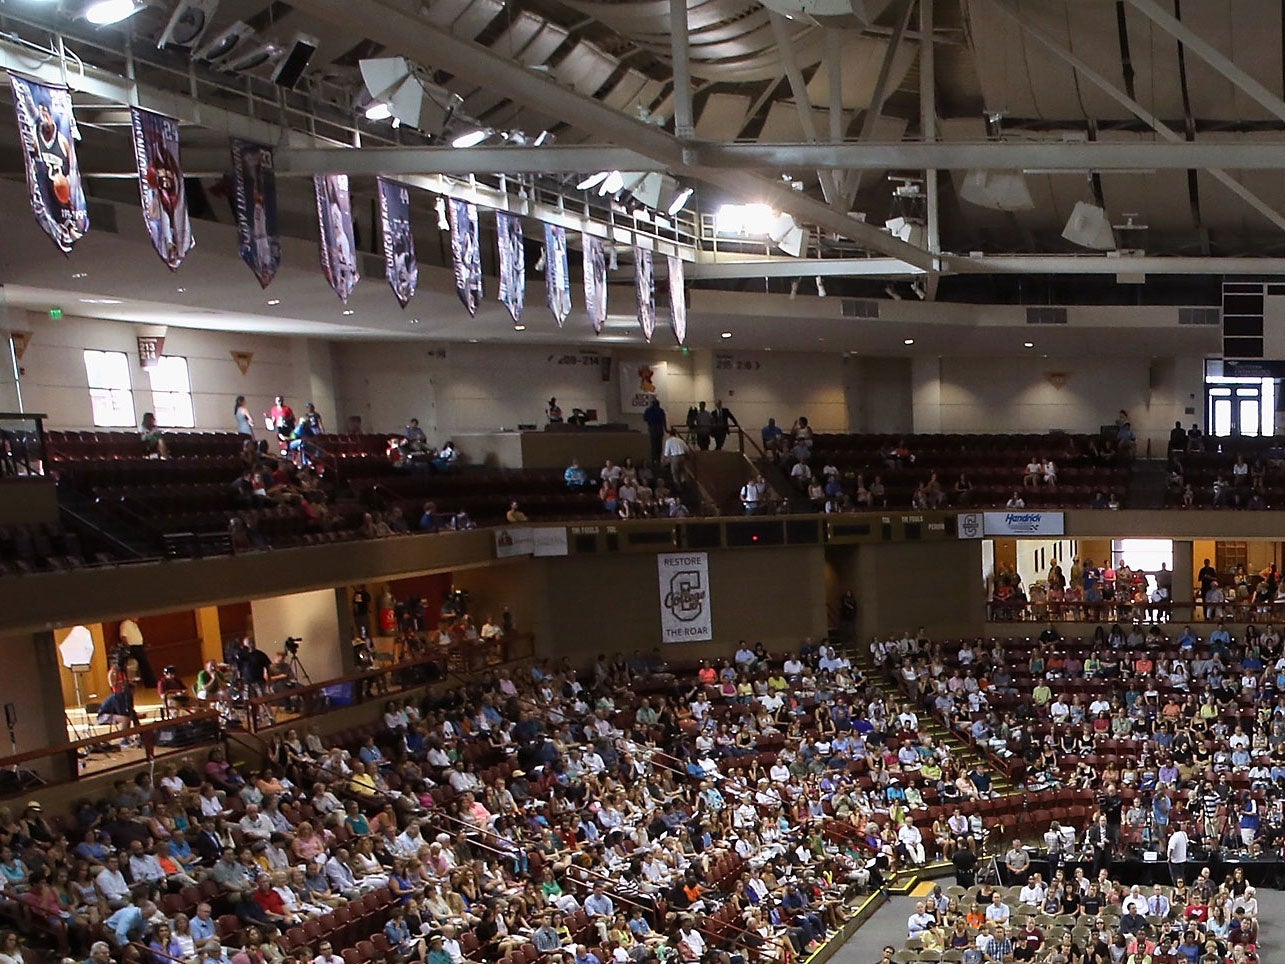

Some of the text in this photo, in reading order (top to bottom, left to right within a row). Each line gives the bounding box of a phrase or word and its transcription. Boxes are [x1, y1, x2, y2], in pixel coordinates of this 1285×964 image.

[1005, 513, 1042, 524] Hendrick
[663, 557, 702, 567] RESTORE
[666, 626, 708, 637] THE ROAR
